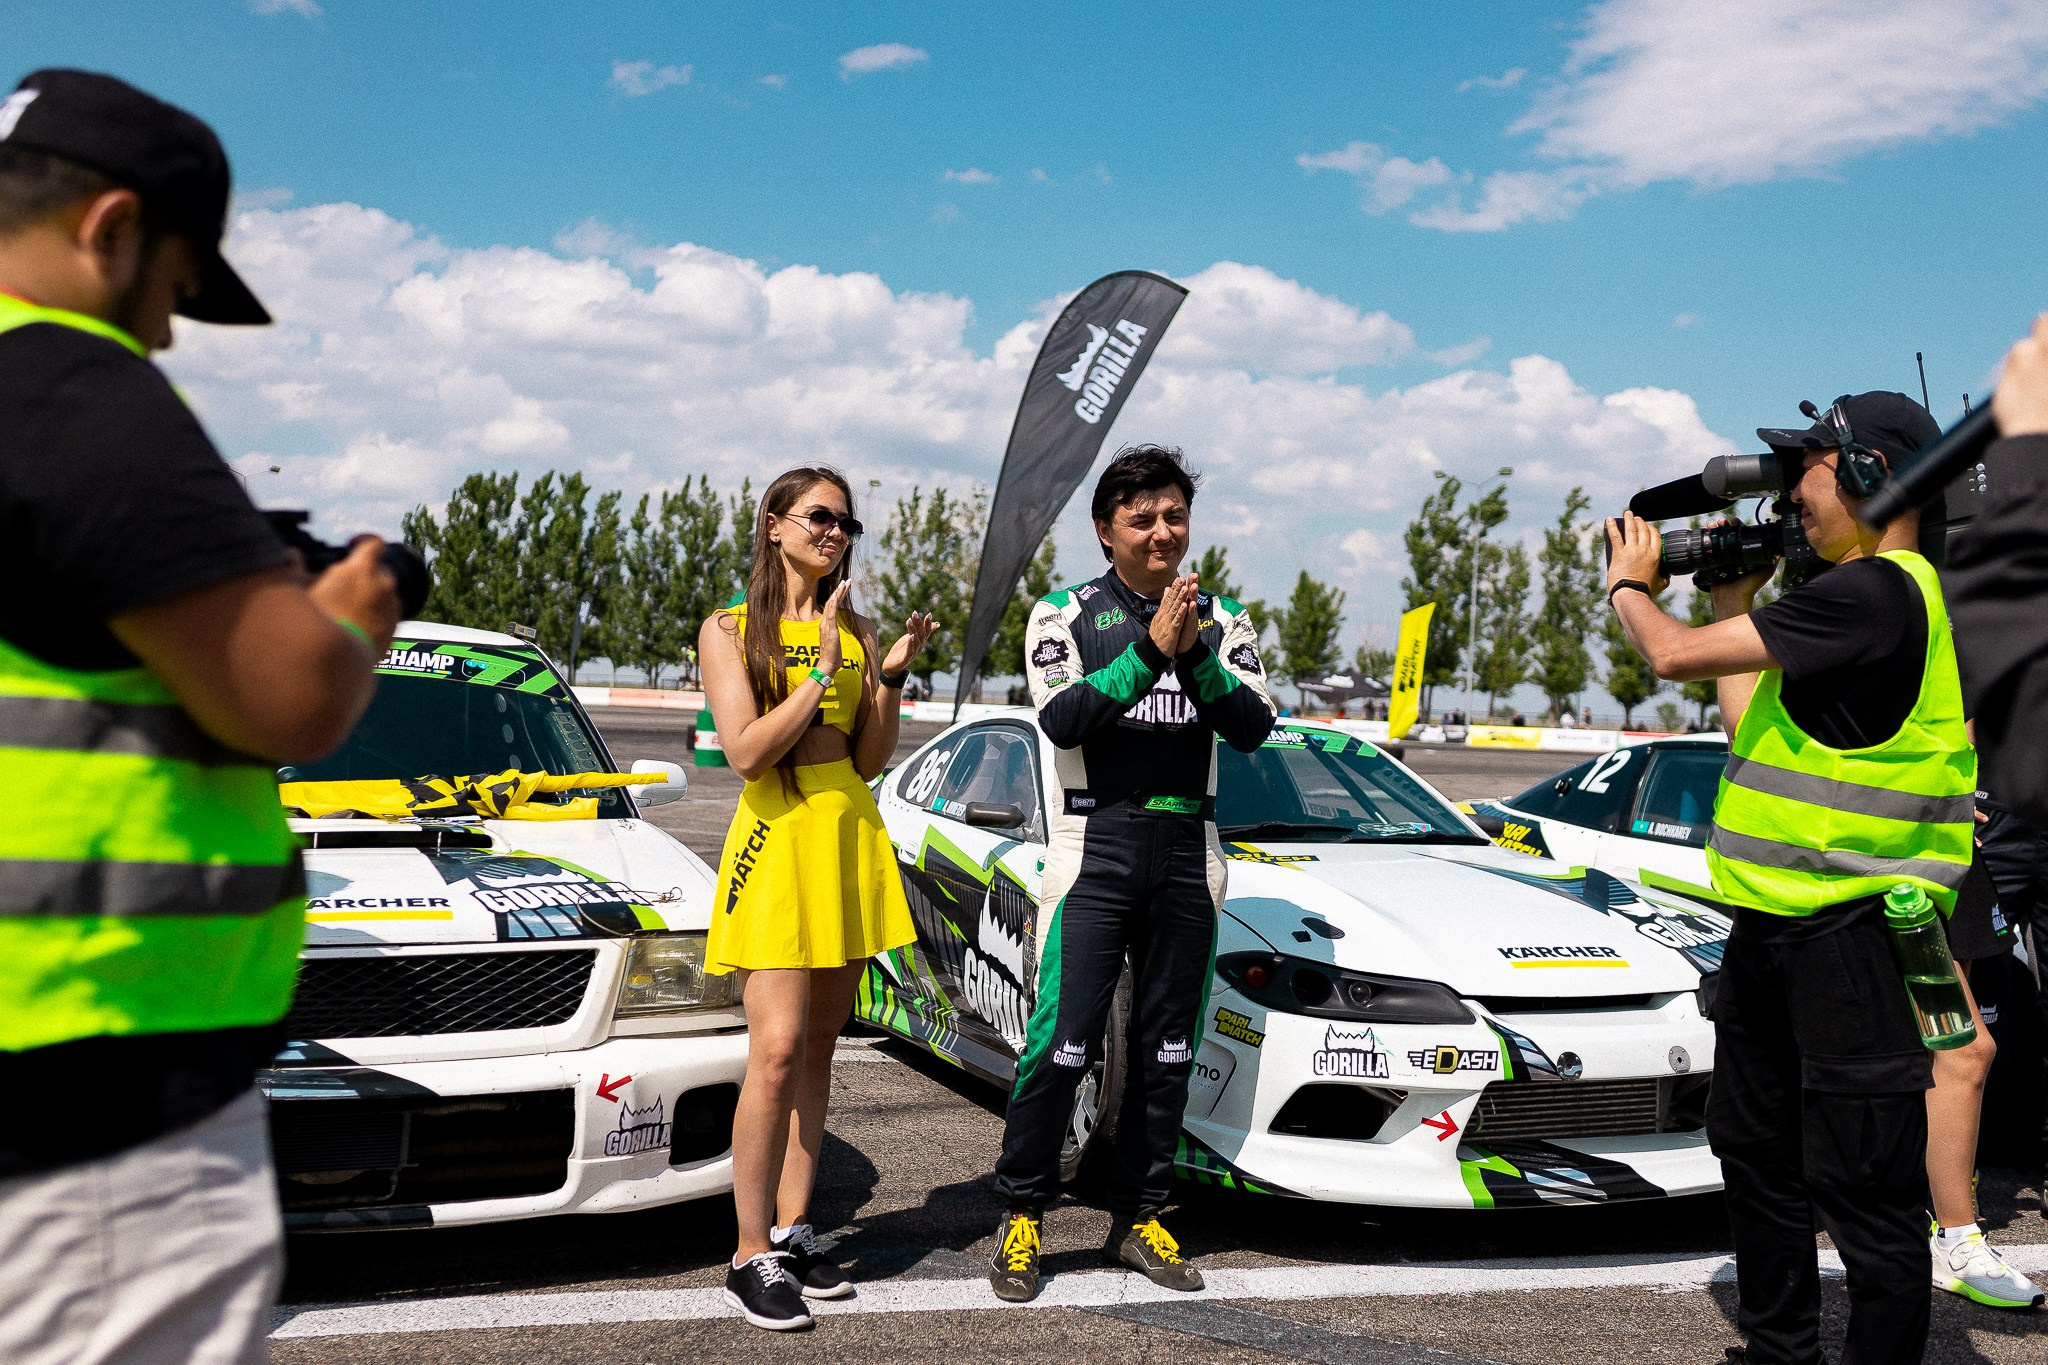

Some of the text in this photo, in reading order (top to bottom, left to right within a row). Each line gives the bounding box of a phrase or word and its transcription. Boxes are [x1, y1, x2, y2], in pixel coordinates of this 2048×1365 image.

[1074, 318, 1149, 425] GORILLA
[905, 749, 951, 803] 86
[1577, 750, 1632, 794] 12
[1503, 822, 1532, 842] ARI
[305, 897, 450, 909] ÄRCHER
[475, 882, 652, 913] GORILLA
[1497, 946, 1622, 959] KÄRCHER
[1217, 1009, 1249, 1028] PARI
[1218, 1021, 1262, 1045] MATCH
[1053, 1050, 1086, 1067] GORILLA
[1158, 1049, 1193, 1063] GORILLA
[1314, 1050, 1390, 1079] GORILLA
[1421, 1045, 1499, 1074] EDASH
[605, 1123, 672, 1156] GORILLA
